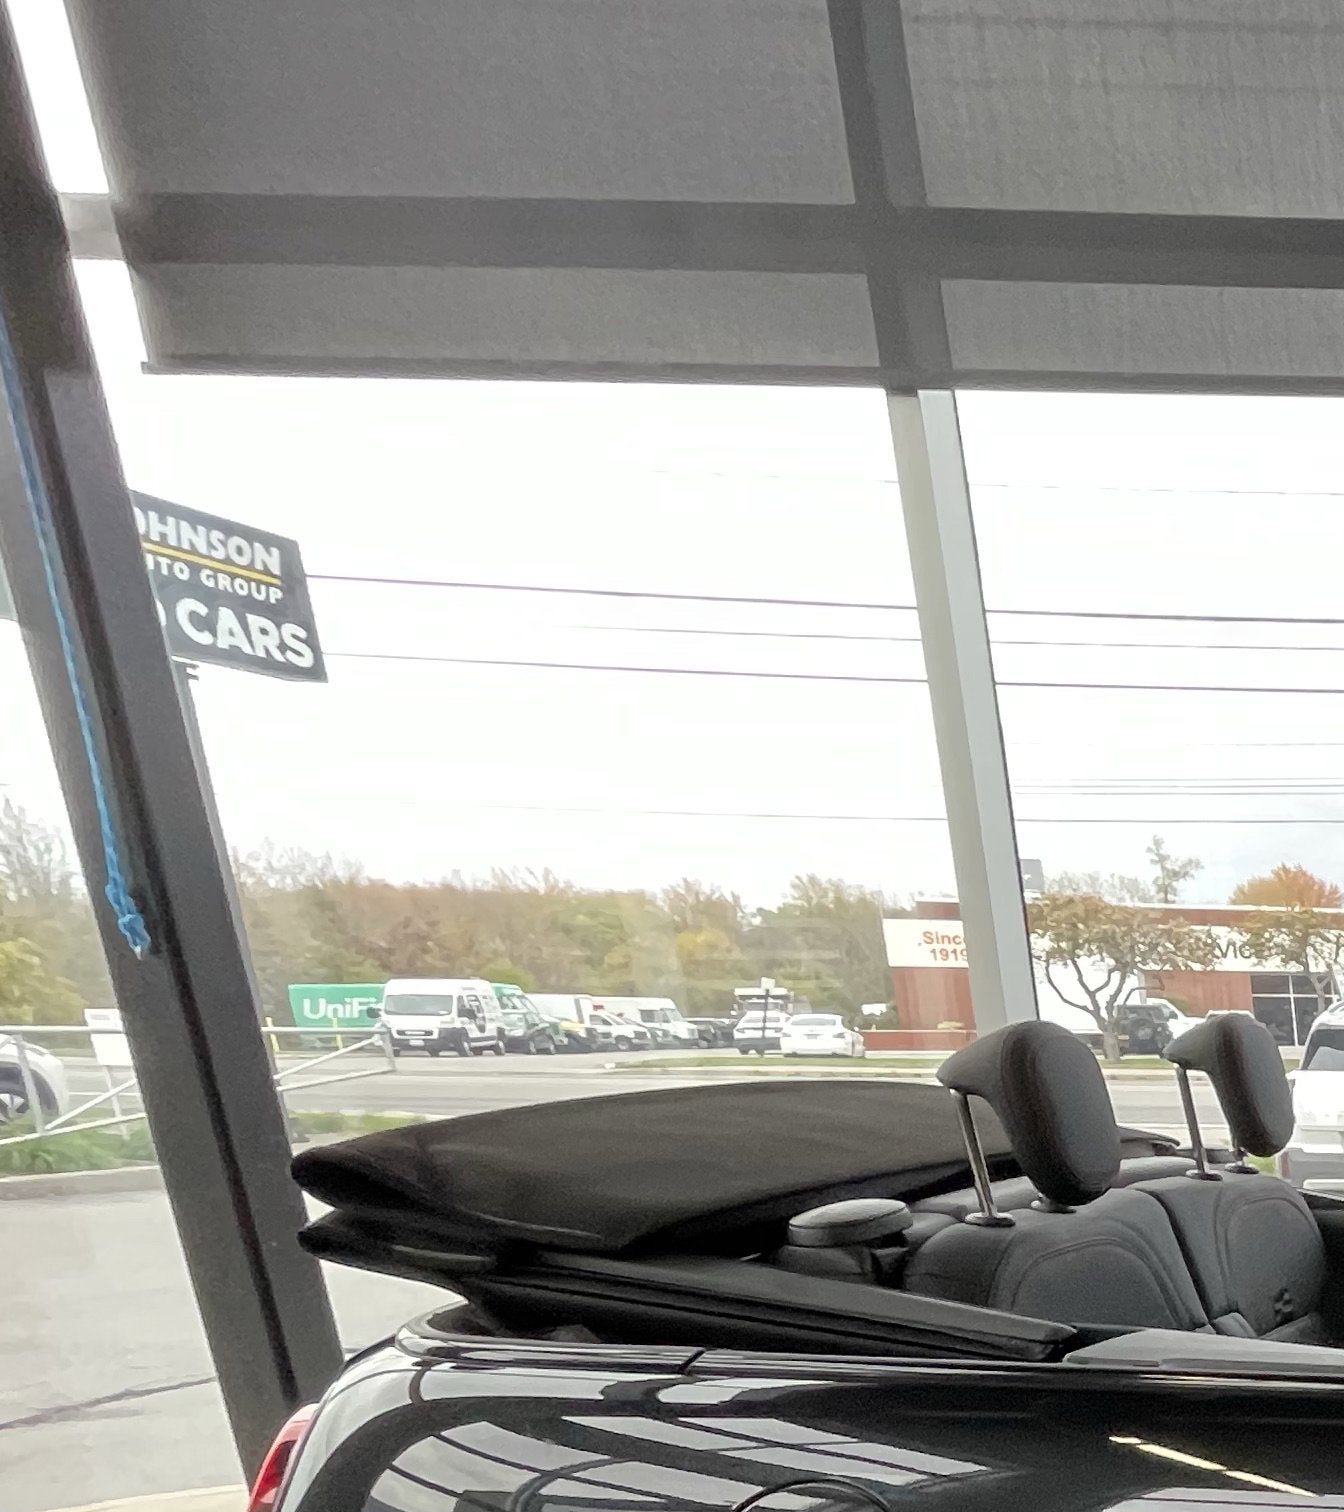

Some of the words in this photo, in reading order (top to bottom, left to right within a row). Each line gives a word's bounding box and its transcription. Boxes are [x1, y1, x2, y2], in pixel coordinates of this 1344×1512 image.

[200, 569, 283, 604] GROUP
[176, 598, 314, 668] CARS
[923, 931, 965, 945] Sinc
